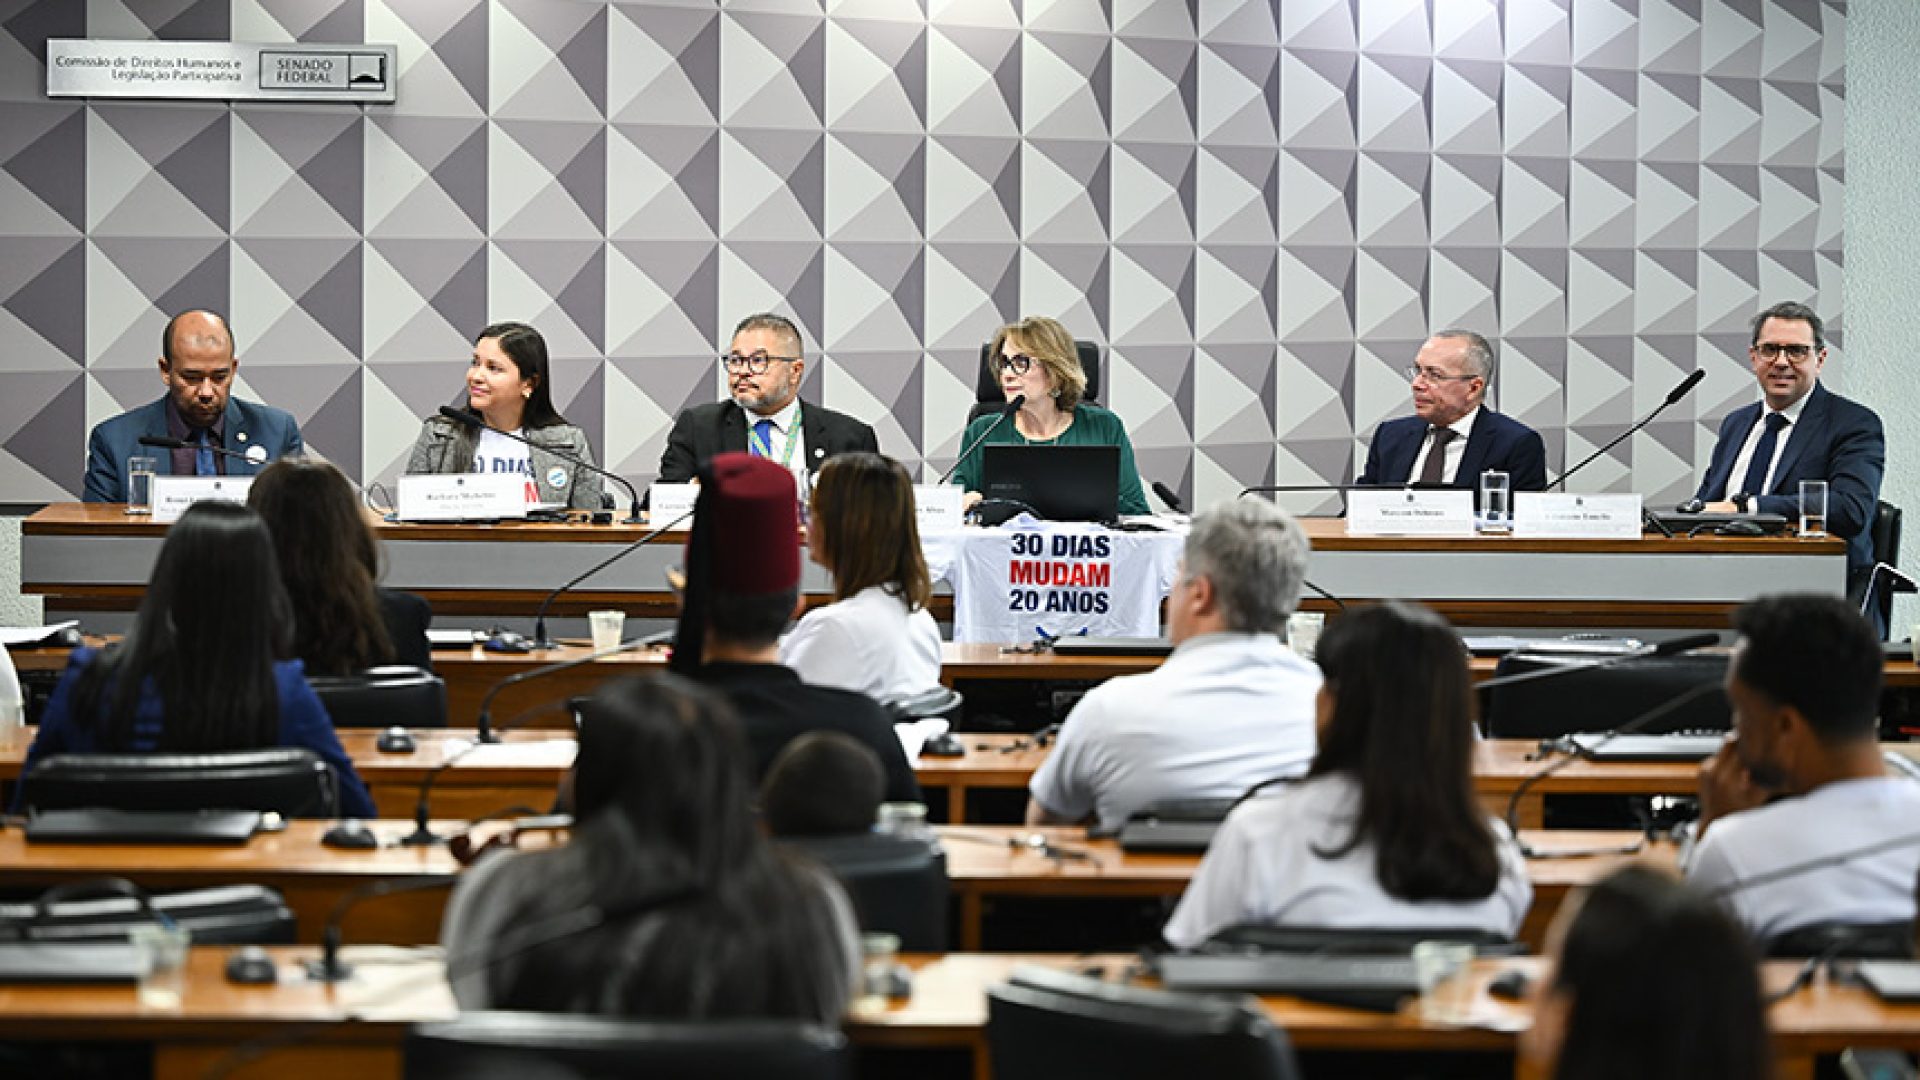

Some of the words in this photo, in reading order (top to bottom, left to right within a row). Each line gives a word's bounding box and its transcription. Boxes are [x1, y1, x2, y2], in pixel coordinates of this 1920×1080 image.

[55, 55, 110, 67] Comissão
[114, 57, 127, 67] de
[131, 56, 175, 68] Direitos
[177, 57, 232, 69] Humanos
[235, 61, 242, 69] e
[277, 58, 333, 71] SENADO
[112, 69, 170, 82] Legislação
[173, 70, 242, 83] Participativa
[276, 71, 331, 82] FEDERAL
[1010, 533, 1044, 556] 30
[1051, 535, 1110, 557] DIAS
[1009, 560, 1110, 587] MUDAM
[1009, 589, 1039, 611] 20
[1045, 591, 1108, 614] ANOS
